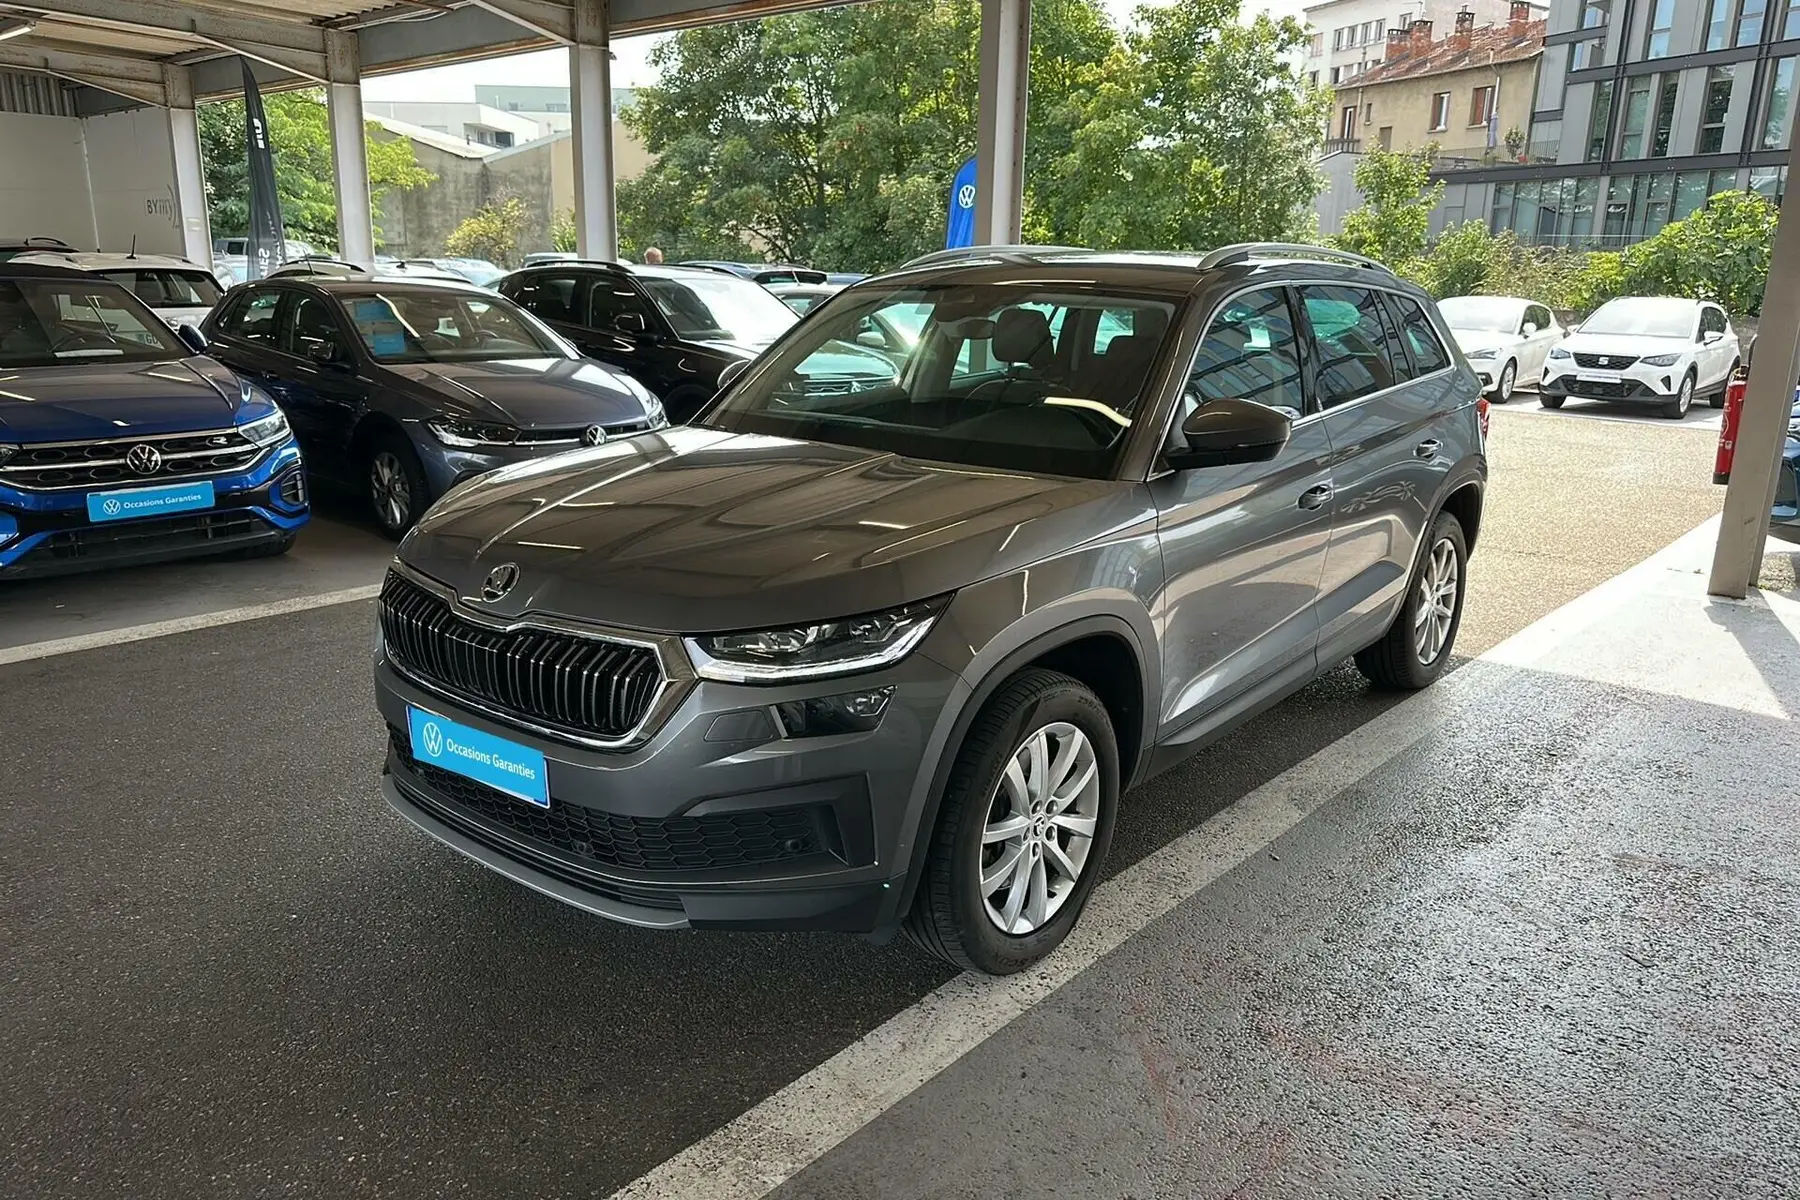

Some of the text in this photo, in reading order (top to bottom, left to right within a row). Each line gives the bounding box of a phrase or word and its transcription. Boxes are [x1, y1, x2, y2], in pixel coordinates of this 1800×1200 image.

[123, 499, 163, 509] Occasions
[165, 493, 202, 504] Garanties
[446, 738, 491, 765] Occasions
[492, 754, 536, 780] Garanties
